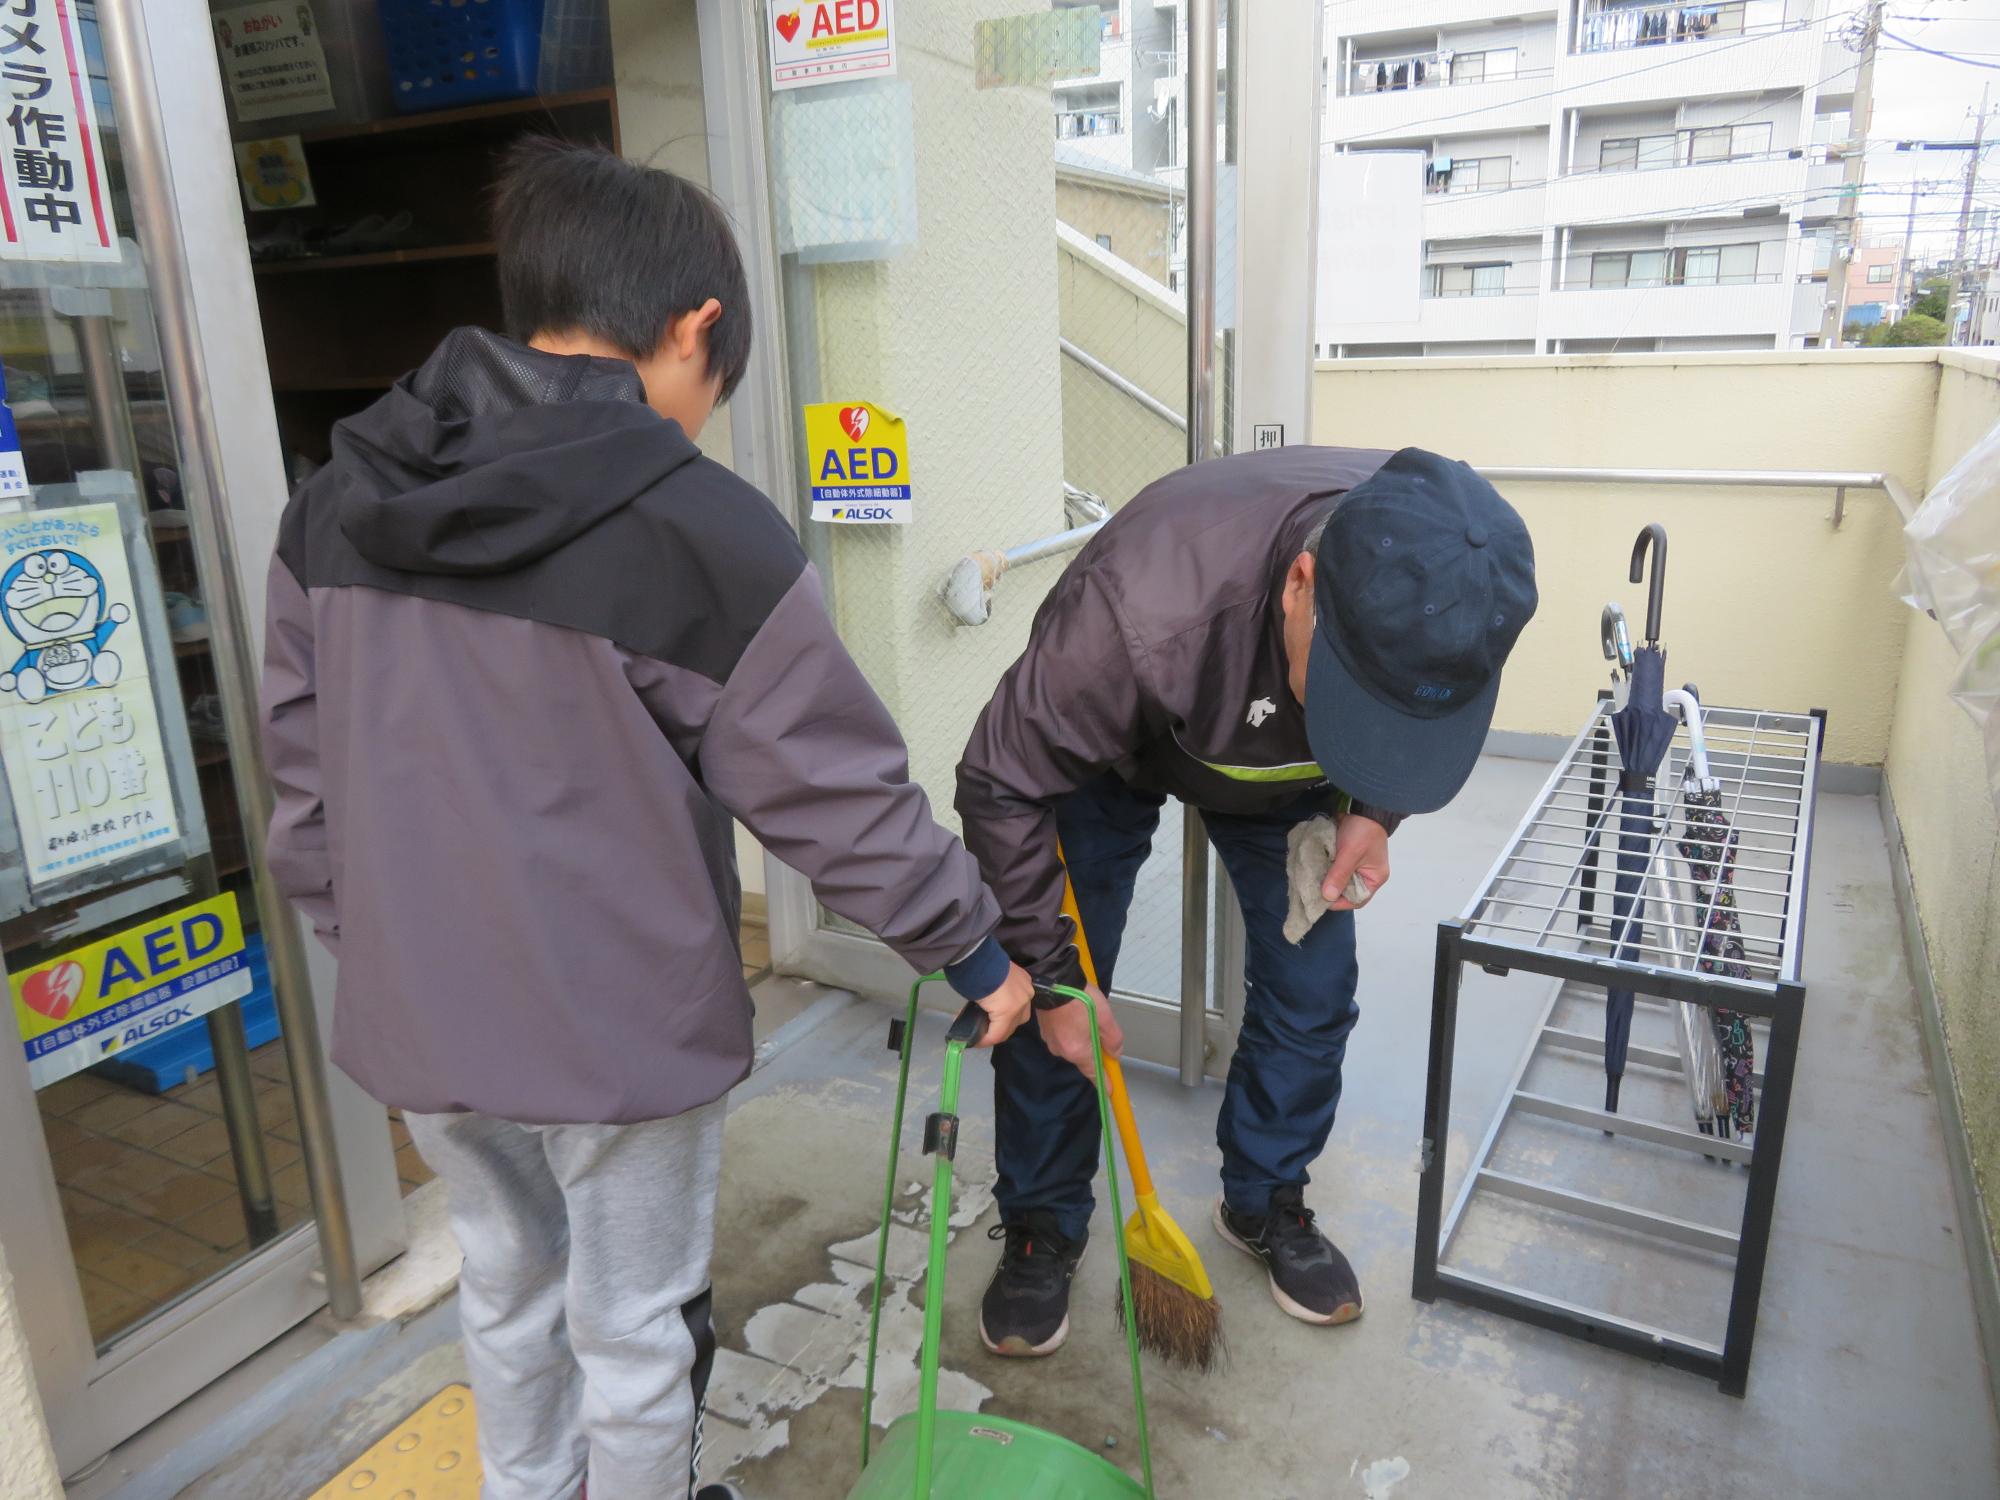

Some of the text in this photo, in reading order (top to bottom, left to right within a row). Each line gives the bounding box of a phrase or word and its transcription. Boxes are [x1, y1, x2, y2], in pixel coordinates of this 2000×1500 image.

[811, 0, 880, 38] AED
[1260, 429, 1277, 448] 押
[820, 447, 898, 480] AED
[845, 507, 893, 520] ALSOK
[25, 696, 136, 762] こども
[123, 809, 153, 828] PTA
[98, 912, 223, 999] AED
[123, 1003, 193, 1046] ALSOK
